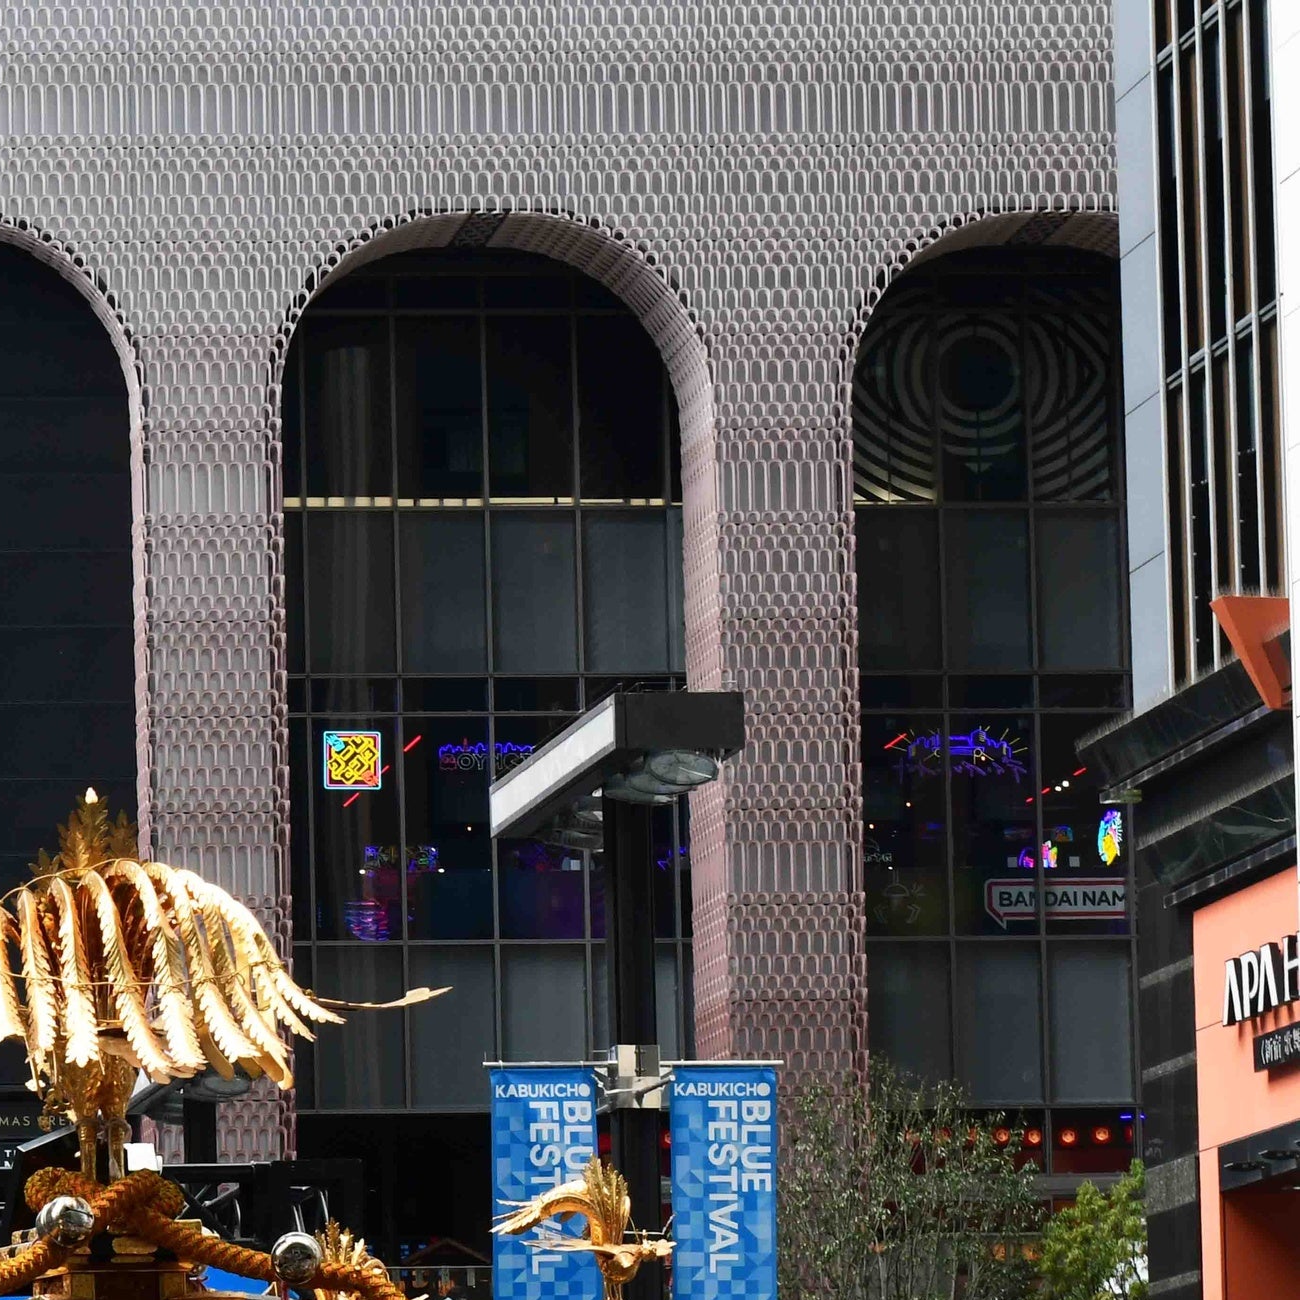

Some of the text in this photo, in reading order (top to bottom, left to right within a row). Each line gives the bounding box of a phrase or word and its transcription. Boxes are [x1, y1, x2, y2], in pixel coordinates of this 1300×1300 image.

[1222, 942, 1280, 1027] APA
[495, 1083, 591, 1098] KABUKICHO
[674, 1082, 771, 1097] KABUKICHO
[708, 1100, 739, 1274] FESTIVAL
[741, 1100, 772, 1192] BLUE
